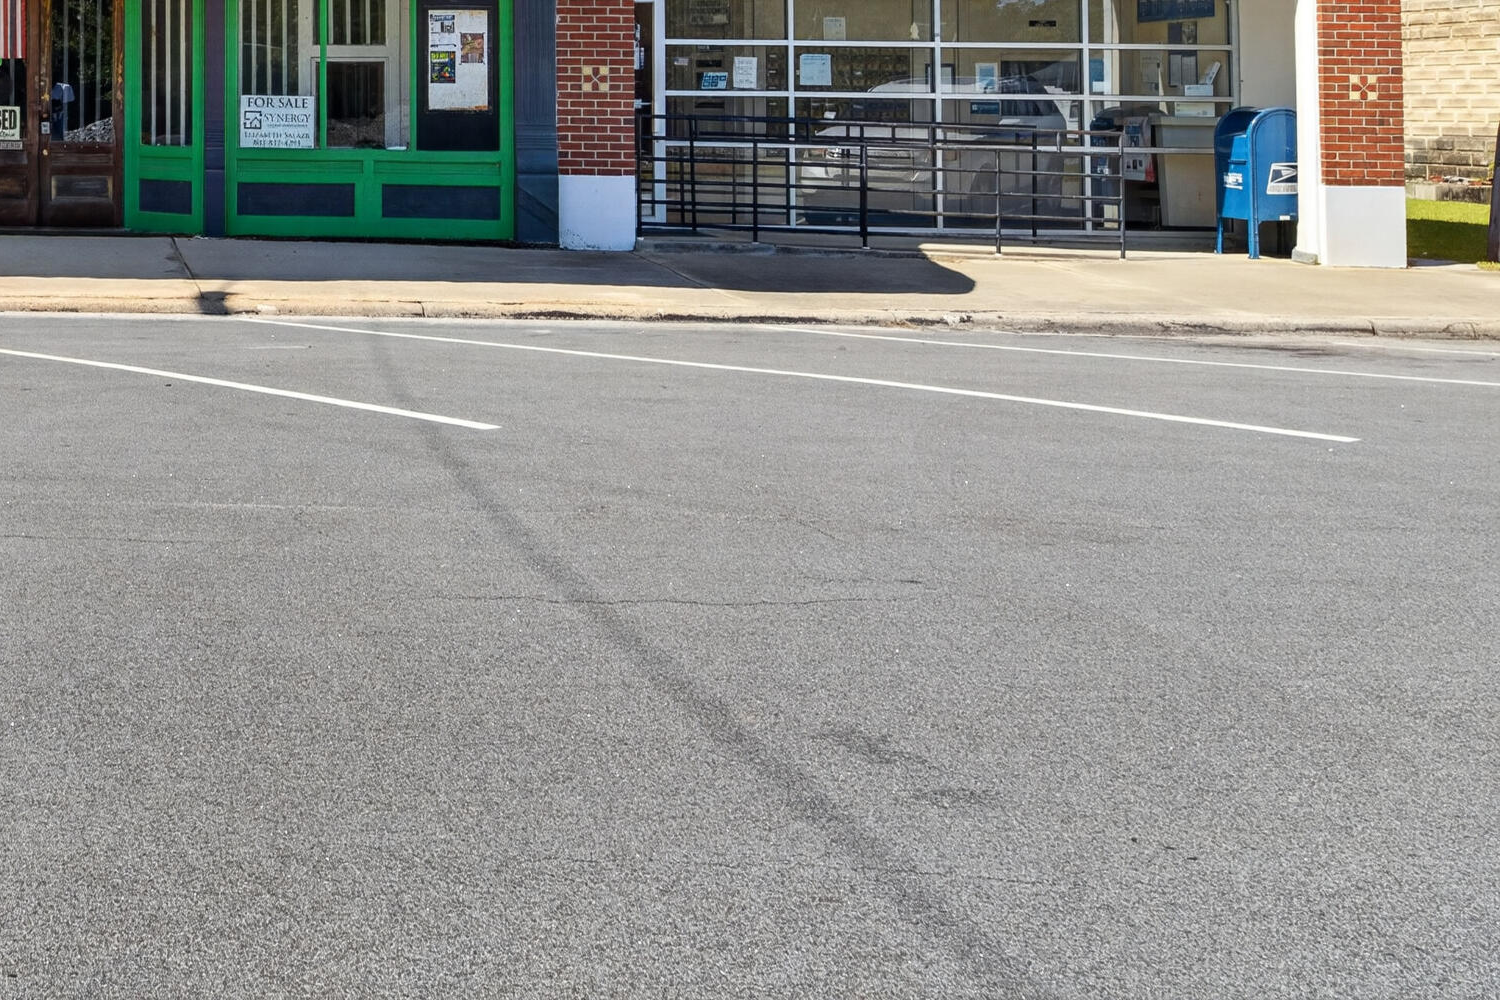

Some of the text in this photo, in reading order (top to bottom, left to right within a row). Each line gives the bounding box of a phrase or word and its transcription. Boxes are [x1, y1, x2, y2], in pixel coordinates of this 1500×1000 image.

[247, 97, 309, 109] FOR SALE
[263, 113, 311, 123] SYNERGY
